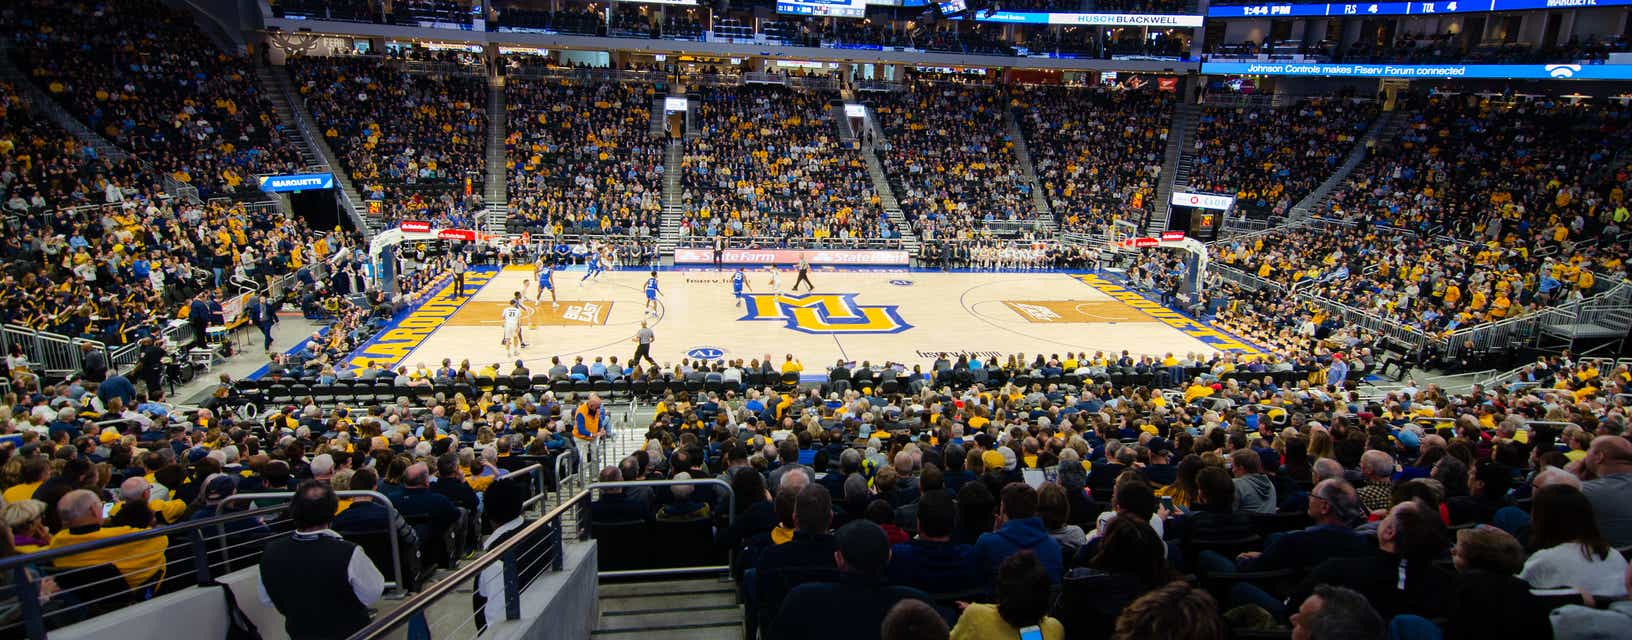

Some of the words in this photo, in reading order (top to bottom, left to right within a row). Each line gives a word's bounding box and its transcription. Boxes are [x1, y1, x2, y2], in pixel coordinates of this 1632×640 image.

[1243, 6, 1268, 15] 1:44
[1271, 6, 1291, 14] PM
[1368, 5, 1378, 13] 4
[1447, 2, 1457, 11] 4
[1248, 64, 1283, 73] Johnson
[1285, 65, 1321, 73] Controls
[1323, 66, 1352, 74] makes
[1354, 66, 1382, 74] Fiserv
[1384, 66, 1414, 75] Forum
[1416, 67, 1465, 75] connected
[272, 177, 322, 188] MARQUETTE
